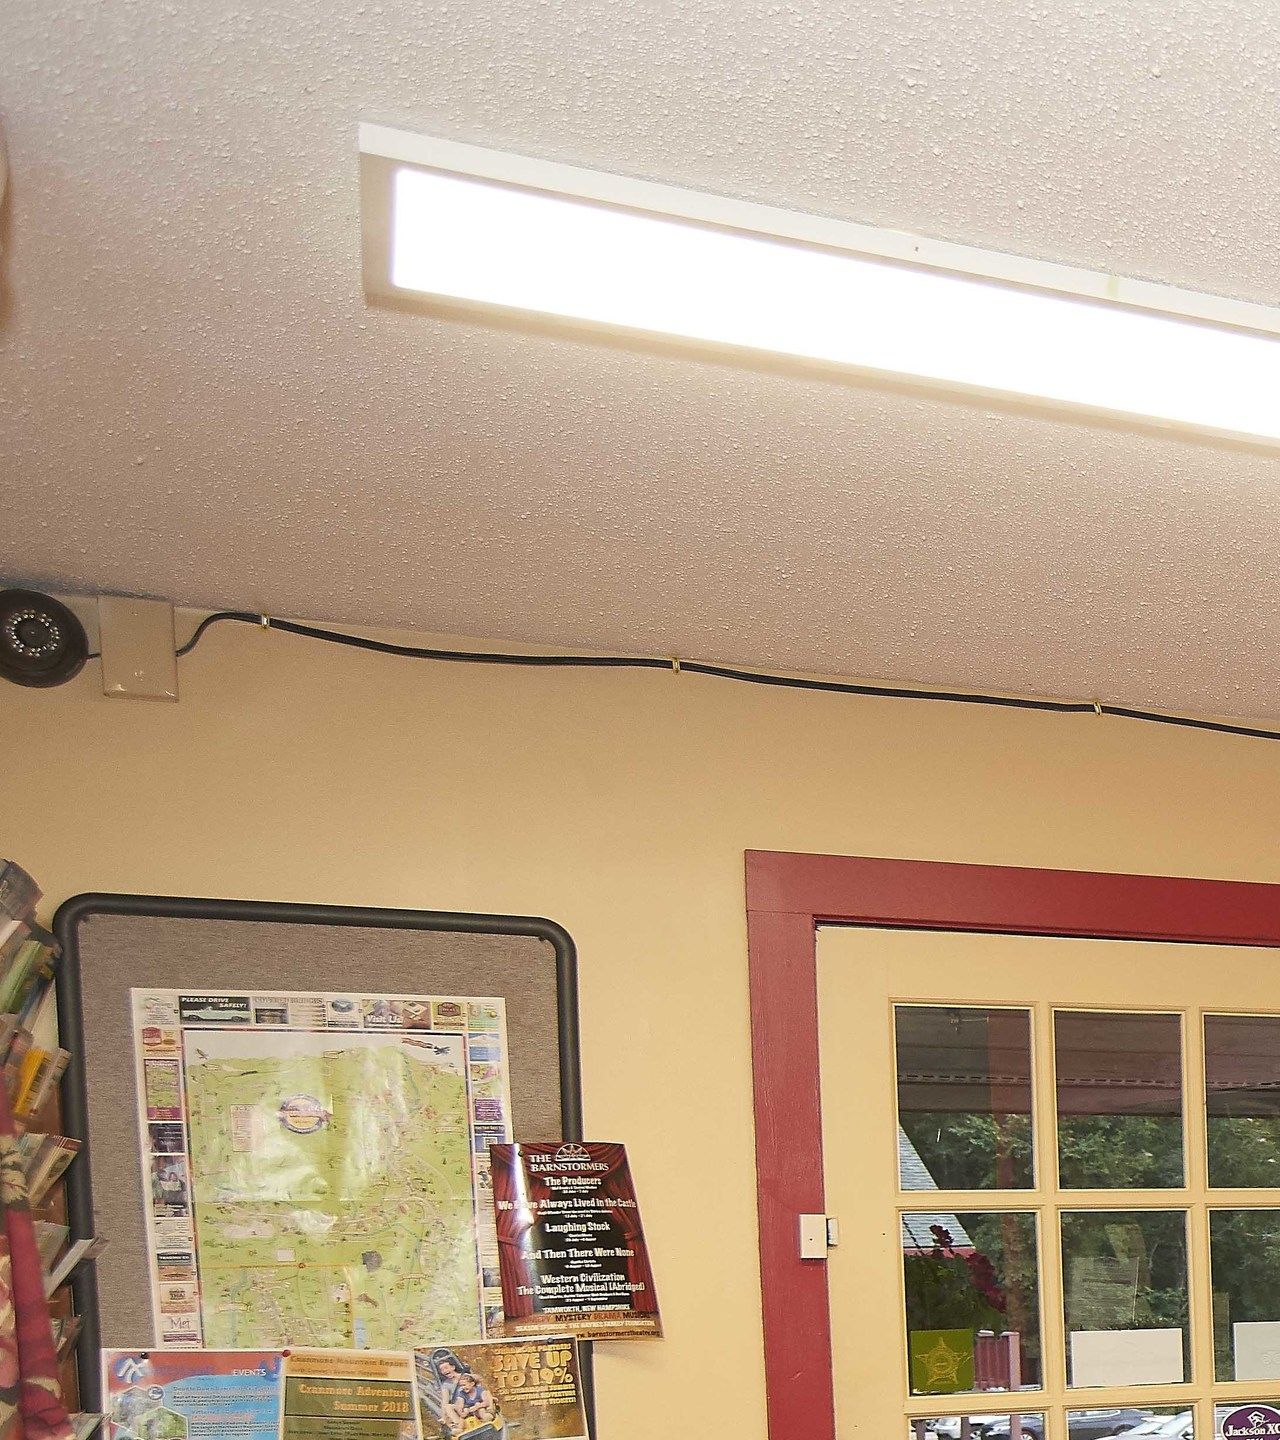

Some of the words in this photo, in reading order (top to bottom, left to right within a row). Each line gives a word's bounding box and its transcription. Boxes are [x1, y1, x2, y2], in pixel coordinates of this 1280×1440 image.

[529, 1154, 551, 1163] THE
[530, 1163, 609, 1172] BARNSTORMERS
[543, 1177, 560, 1186] The
[561, 1176, 601, 1186] Producers
[498, 1200, 513, 1210] We
[540, 1199, 573, 1210] Always
[573, 1198, 595, 1208] Lived
[597, 1198, 604, 1207] in
[605, 1198, 617, 1207] the
[545, 1222, 587, 1233] Laughing
[587, 1221, 610, 1231] Stock
[542, 1248, 566, 1259] Then
[567, 1247, 593, 1258] There
[594, 1247, 615, 1258] Were
[615, 1247, 634, 1257] None
[540, 1274, 578, 1284] Western
[580, 1272, 625, 1283] Civilization
[517, 1285, 534, 1296] The
[534, 1283, 574, 1295] Complete
[575, 1282, 608, 1293] Musical
[555, 1313, 592, 1322] MYSTERY
[492, 1353, 541, 1372] SAVE
[546, 1350, 573, 1368] UP
[233, 1368, 267, 1377] EVENTS
[493, 1370, 526, 1388] TO
[530, 1367, 574, 1386] 19%
[299, 1383, 354, 1396] Cranmore
[355, 1385, 410, 1398] Adventure
[333, 1400, 379, 1412] Summer
[380, 1401, 410, 1413] 2018
[1226, 1424, 1266, 1437] Jackson
